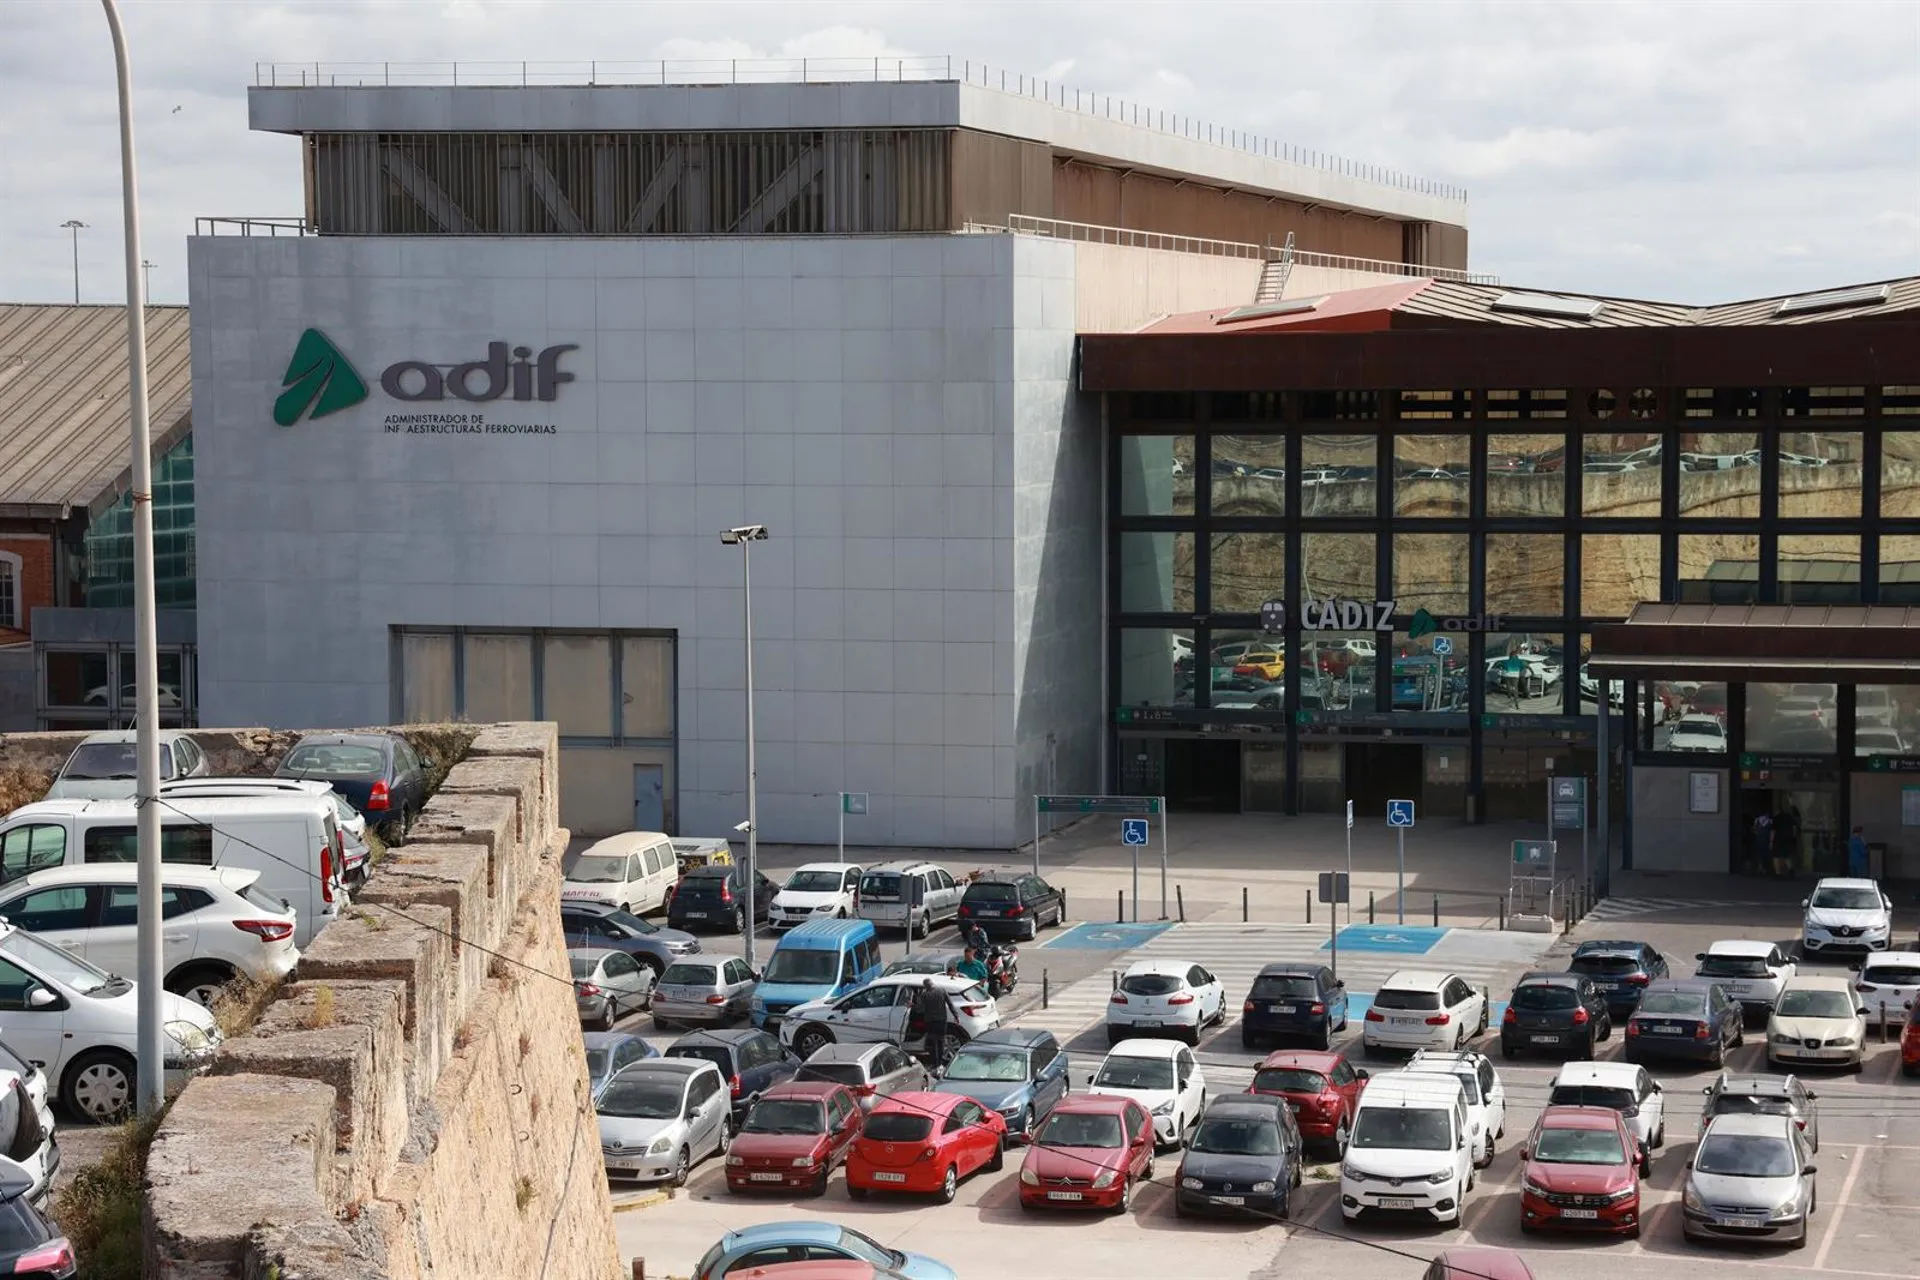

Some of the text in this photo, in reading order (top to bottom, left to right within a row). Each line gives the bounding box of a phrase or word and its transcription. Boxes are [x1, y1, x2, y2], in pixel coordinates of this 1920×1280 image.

[380, 341, 580, 402] adif
[384, 414, 484, 424] ADMINISTRADOR DE
[485, 424, 557, 435] FERROVIARIAS
[1300, 594, 1396, 631] CÁDIZ
